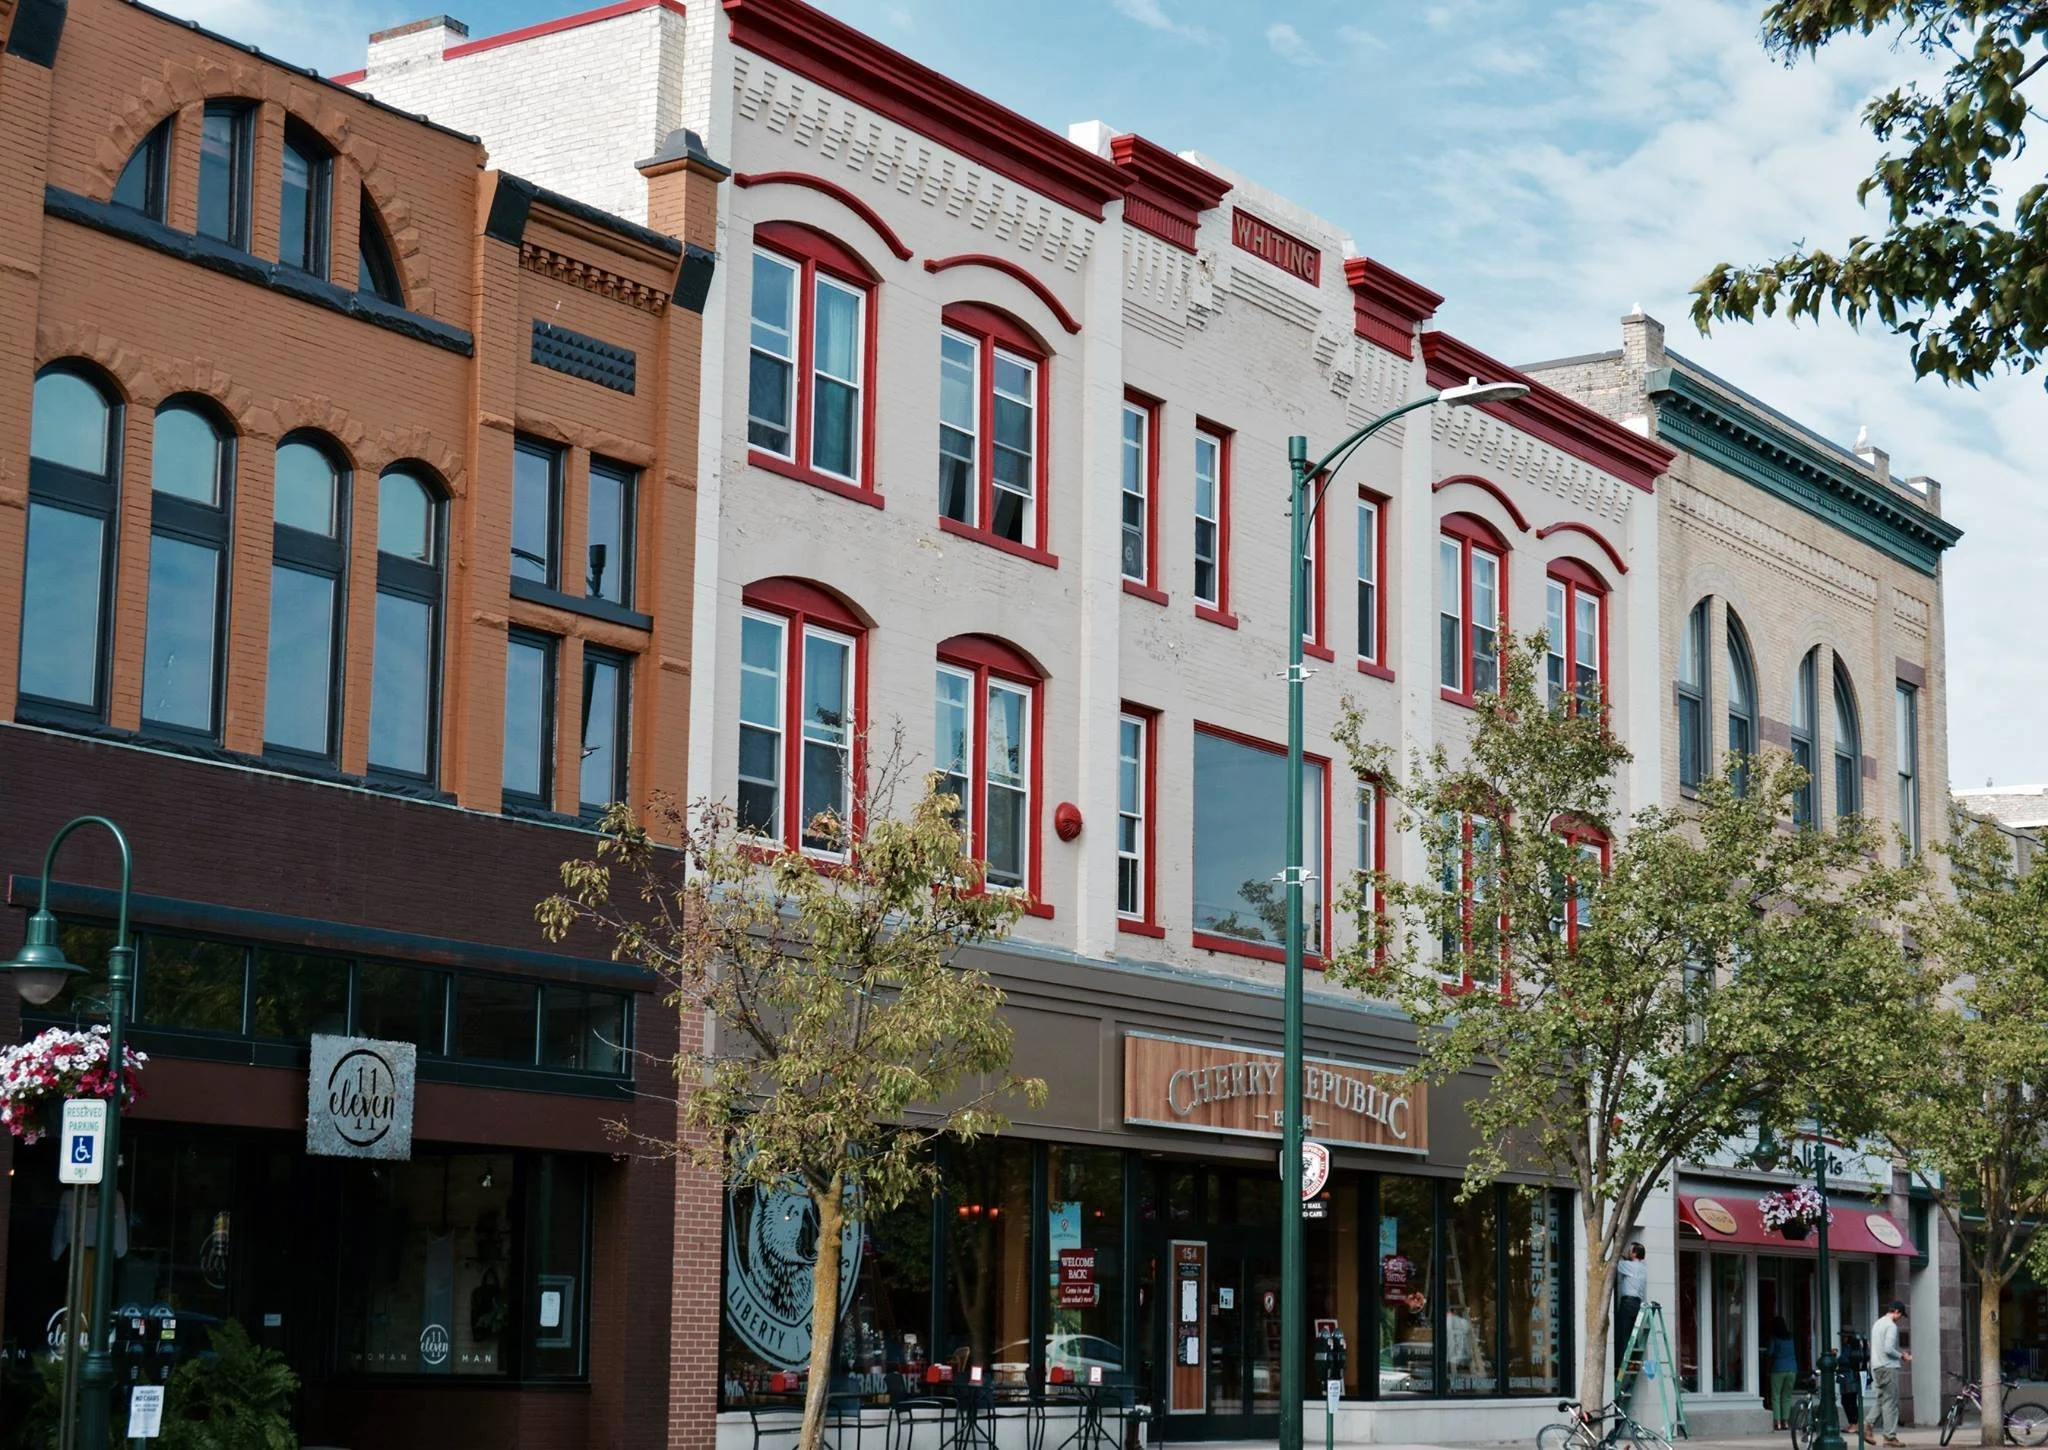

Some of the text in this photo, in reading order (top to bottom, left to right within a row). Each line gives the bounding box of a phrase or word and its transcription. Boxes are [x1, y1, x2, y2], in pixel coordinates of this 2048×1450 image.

[1233, 213, 1315, 283] WHITING
[329, 1079, 395, 1121] eleven
[1168, 1061, 1409, 1140] CHERRY EPUBLIC
[67, 1105, 103, 1118] RESERVED
[68, 1121, 100, 1132] PARKING
[1061, 1256, 1095, 1268] WELCOME
[1182, 1247, 1198, 1260] 154
[729, 1286, 786, 1350] LIBERTY
[420, 1336, 449, 1353] eleven
[1530, 1329, 1545, 1366] PIE
[461, 1354, 492, 1364] MAN
